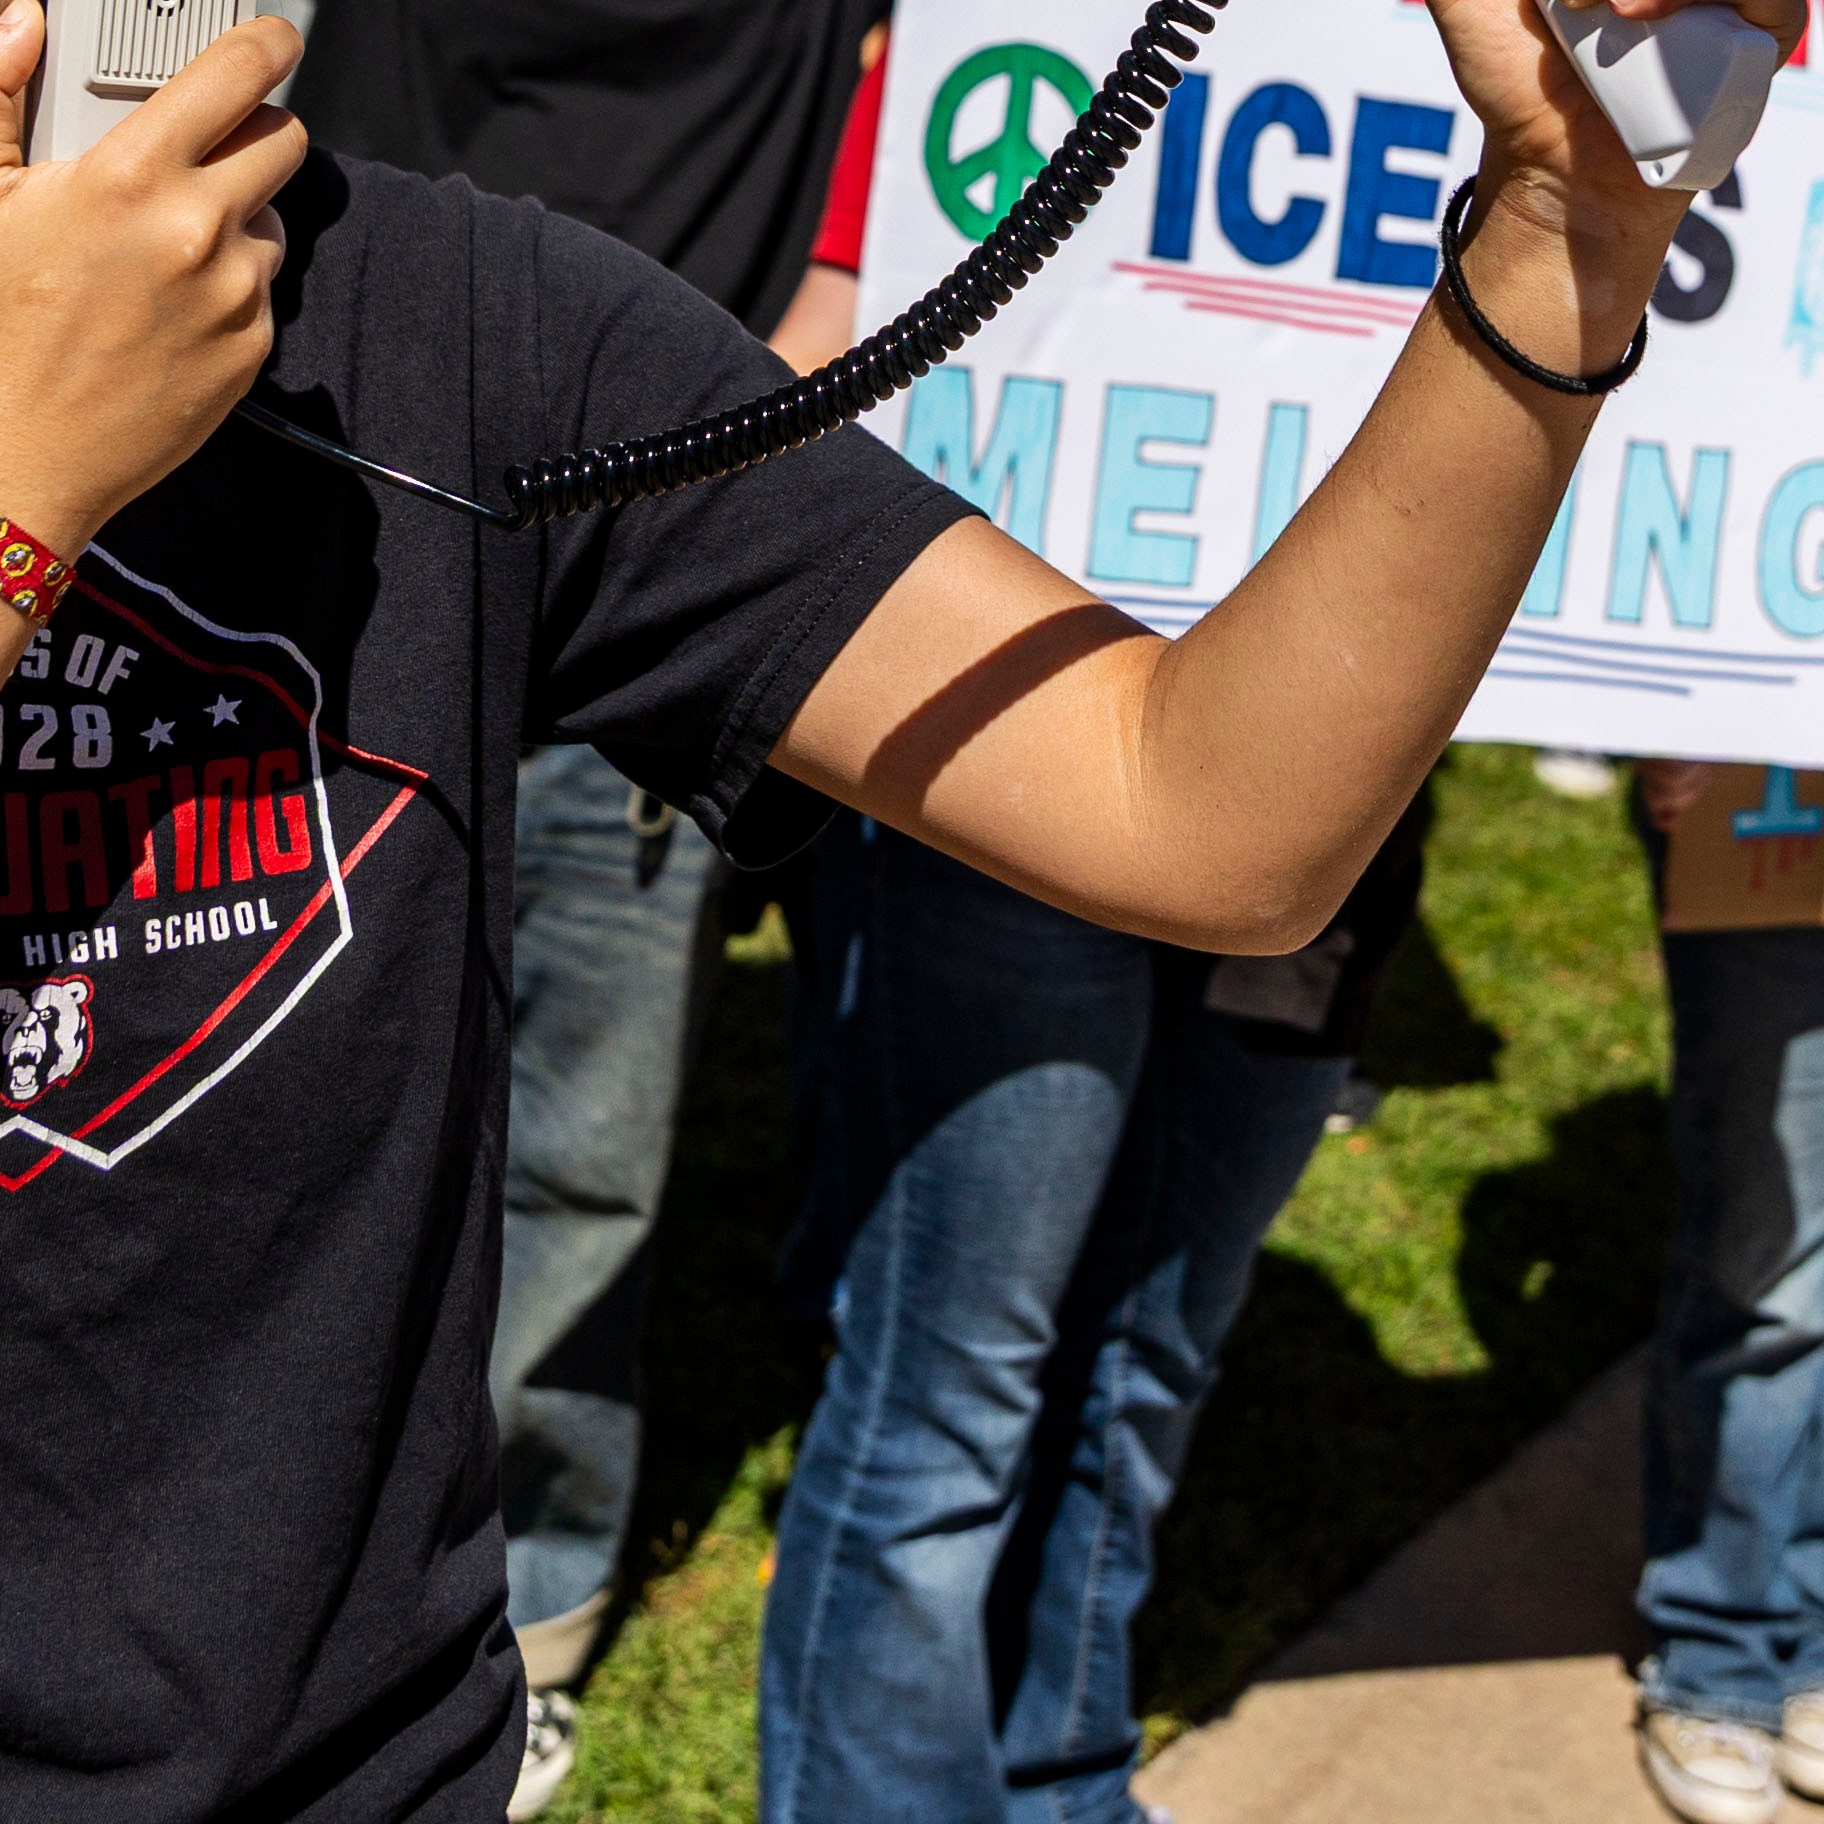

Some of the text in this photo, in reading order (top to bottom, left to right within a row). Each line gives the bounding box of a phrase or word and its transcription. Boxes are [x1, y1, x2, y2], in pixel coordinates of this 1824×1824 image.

[1147, 68, 1457, 288] ICE
[64, 633, 140, 695] OF
[23, 924, 119, 969] HIGH
[145, 897, 278, 956] SCHOOL
